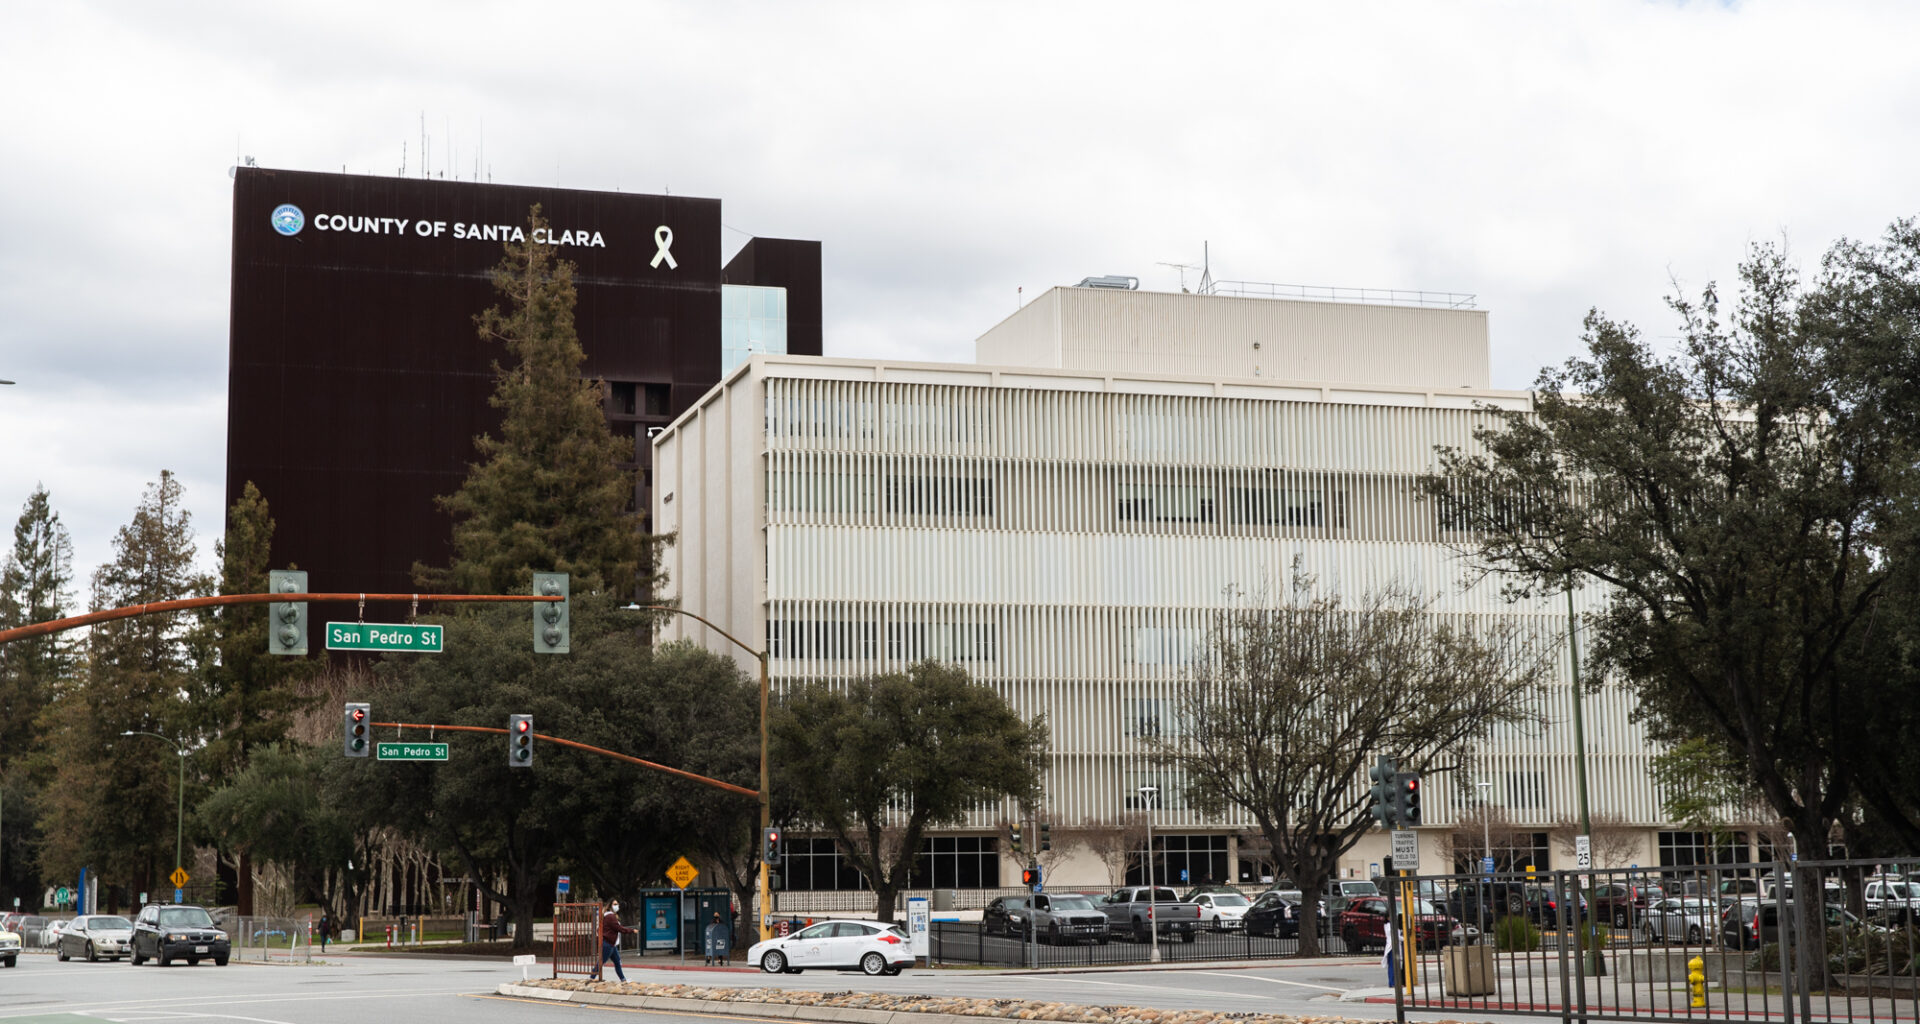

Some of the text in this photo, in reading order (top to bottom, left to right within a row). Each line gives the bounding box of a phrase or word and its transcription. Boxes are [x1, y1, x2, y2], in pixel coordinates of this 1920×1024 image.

[314, 213, 606, 248] COUNTY OF SANTA CLARA
[333, 629, 436, 646] San Pedro St
[381, 746, 445, 757] San Pedro St
[1578, 853, 1590, 866] 25
